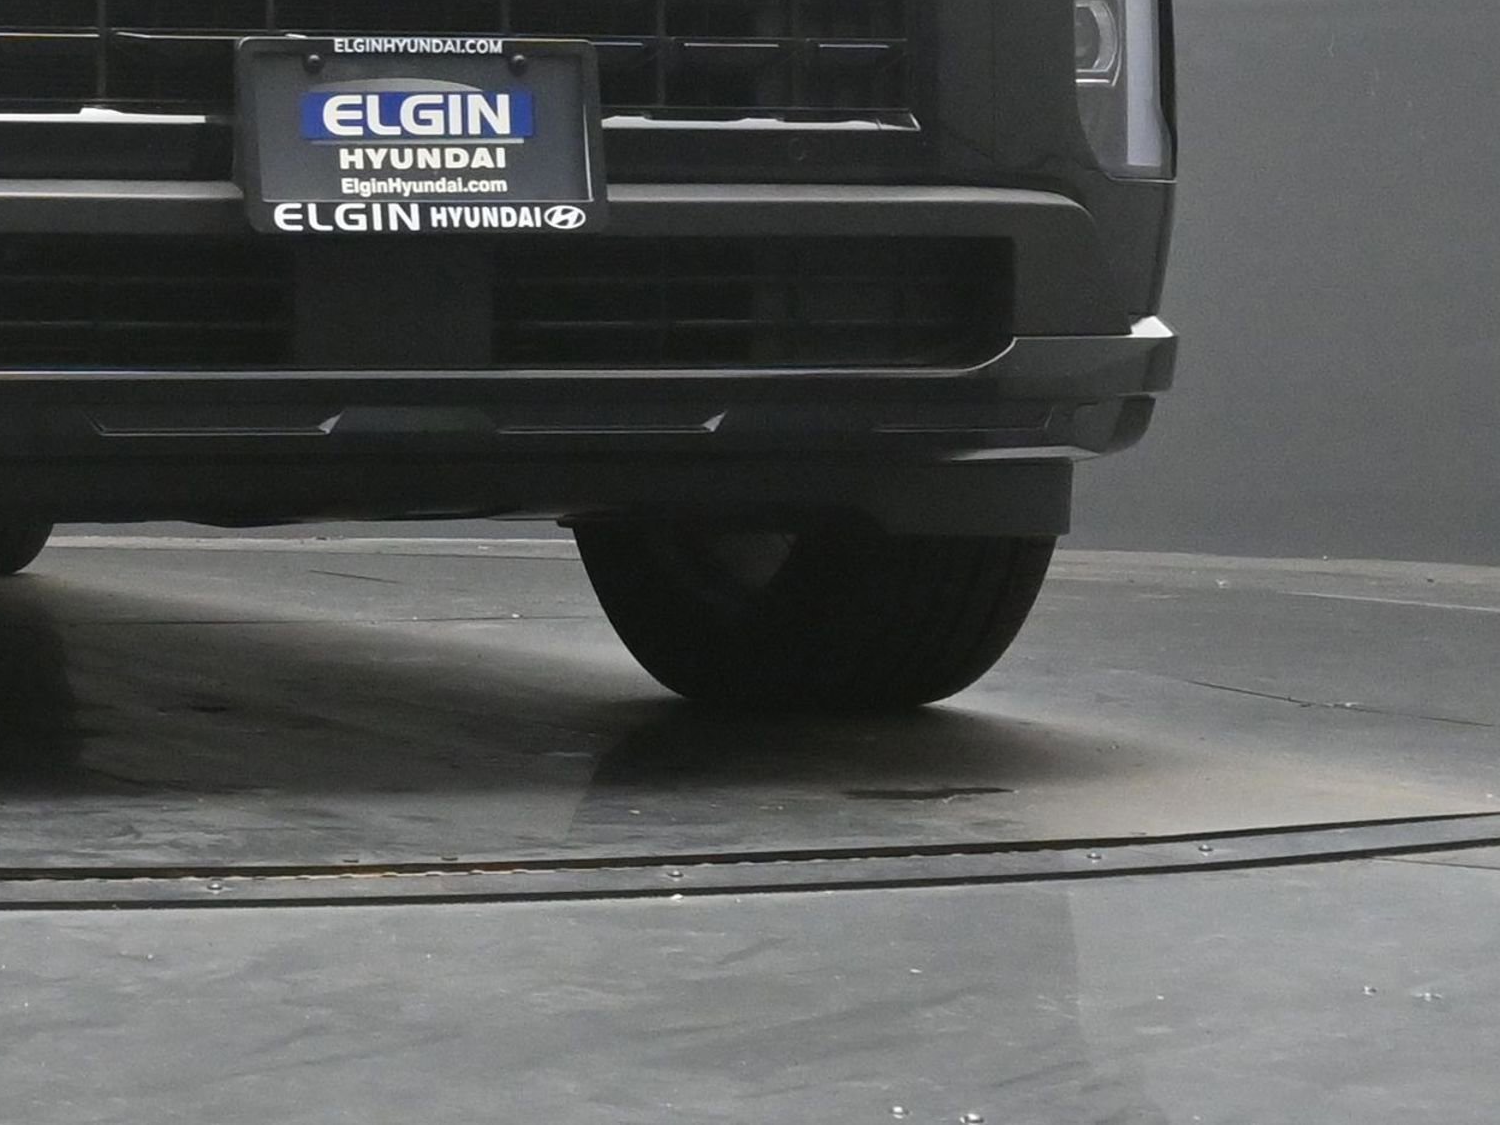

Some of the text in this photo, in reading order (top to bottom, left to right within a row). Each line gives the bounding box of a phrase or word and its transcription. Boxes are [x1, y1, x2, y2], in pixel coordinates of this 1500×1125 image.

[333, 38, 503, 54] ELGINHYUNDAI.COM
[322, 93, 511, 136] ELGIN
[339, 147, 506, 169] HYUNDAI
[341, 178, 507, 197] ElginHyundai.com
[273, 202, 542, 231] ELGIN HYUNDAI
